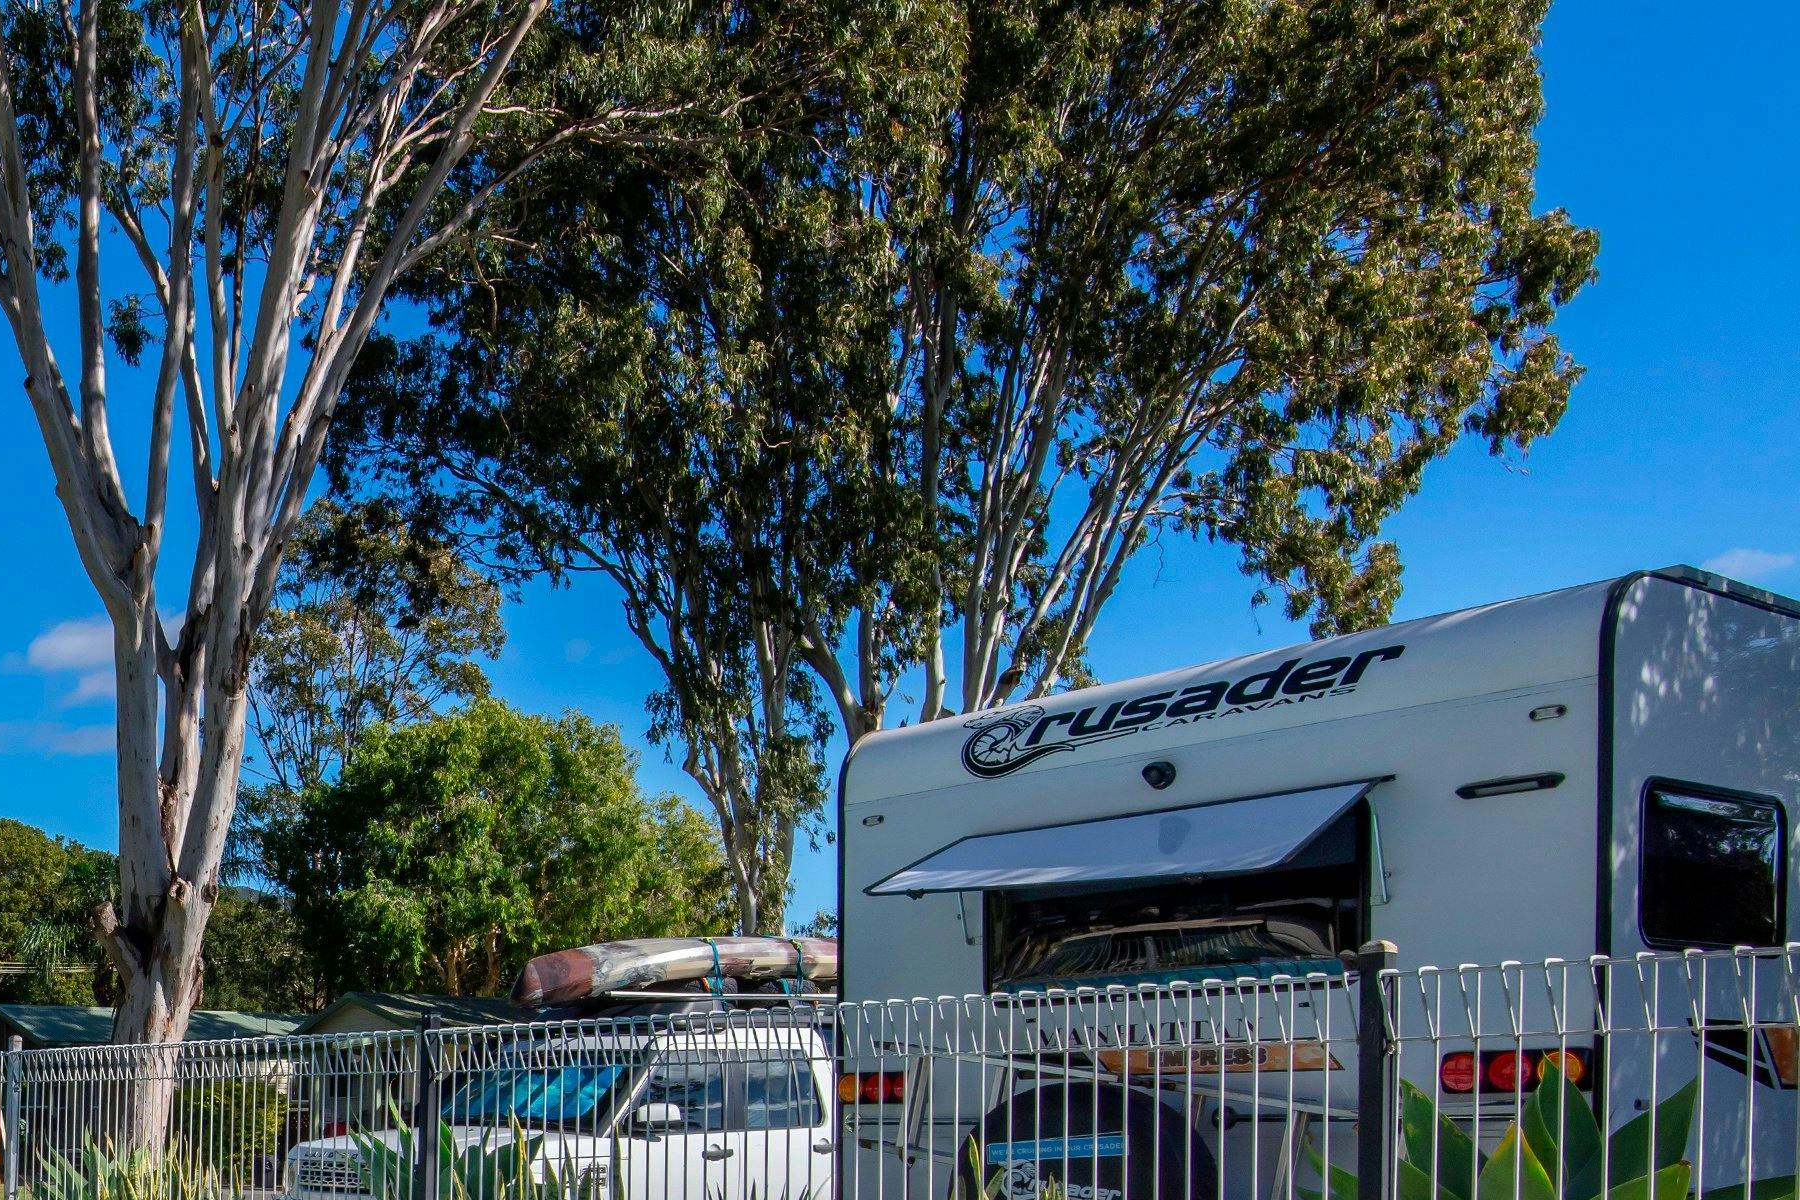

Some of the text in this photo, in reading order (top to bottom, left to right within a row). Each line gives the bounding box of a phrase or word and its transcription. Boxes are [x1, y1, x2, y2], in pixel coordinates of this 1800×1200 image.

[1141, 687, 1356, 733] CARAVANS
[1038, 1016, 1264, 1048] MANHATTAN
[1146, 1045, 1267, 1069] EMPRESS
